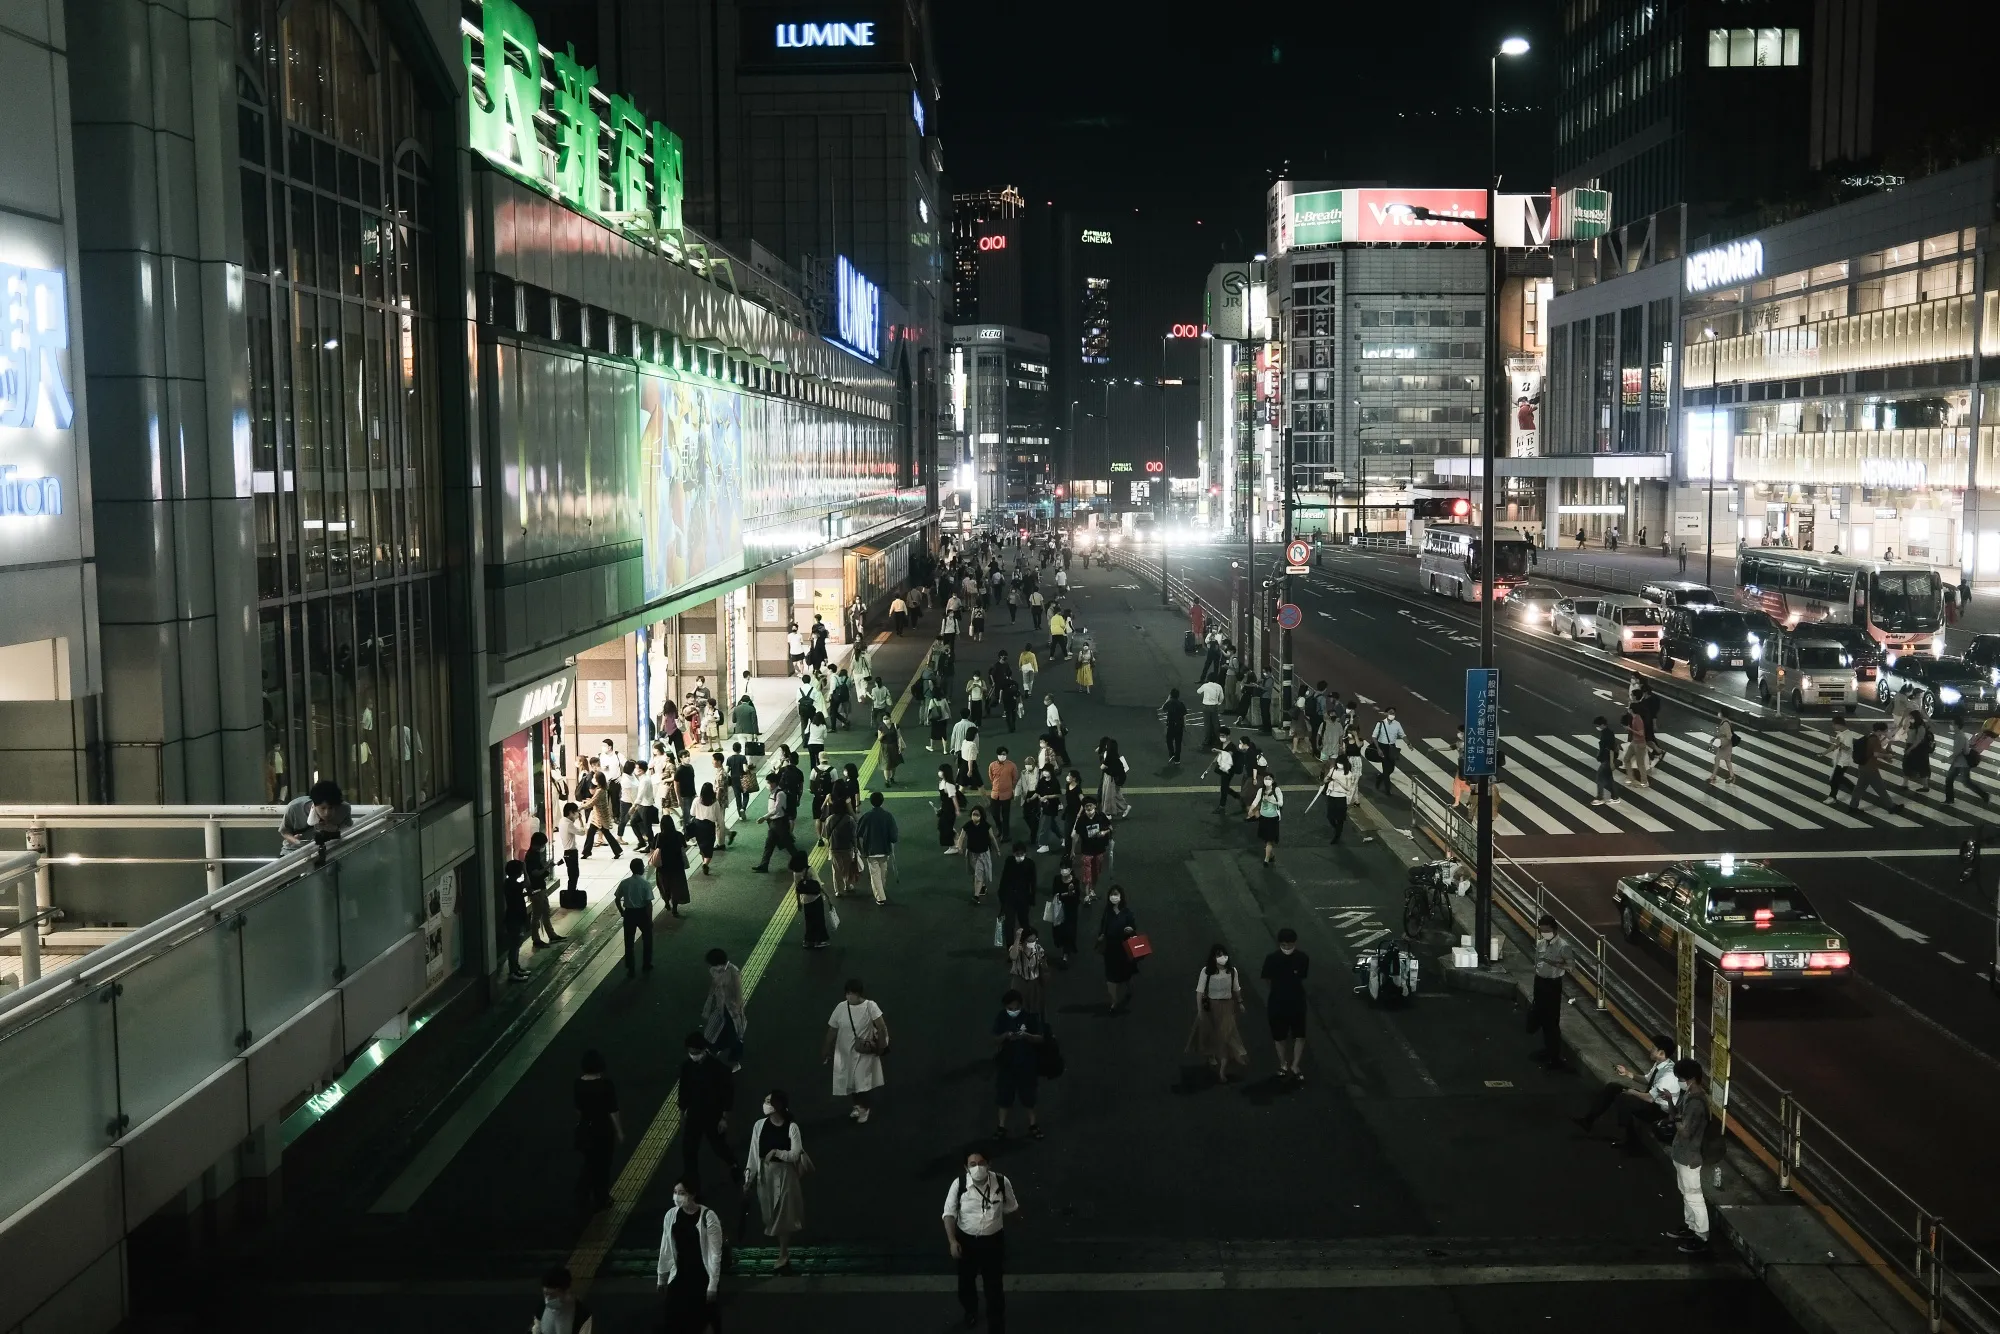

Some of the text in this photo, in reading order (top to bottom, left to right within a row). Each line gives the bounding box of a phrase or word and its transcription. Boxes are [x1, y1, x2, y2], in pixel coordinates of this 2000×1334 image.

[777, 22, 875, 47] LUMINE
[1368, 202, 1476, 227] Vicoria
[1081, 235, 1113, 245] CINEMA
[1222, 297, 1242, 309] JR
[1476, 690, 1487, 754] バスタ新宿へは
[1485, 673, 1497, 765] 一般車・原付・自転車は
[1466, 727, 1477, 773] 入れません
